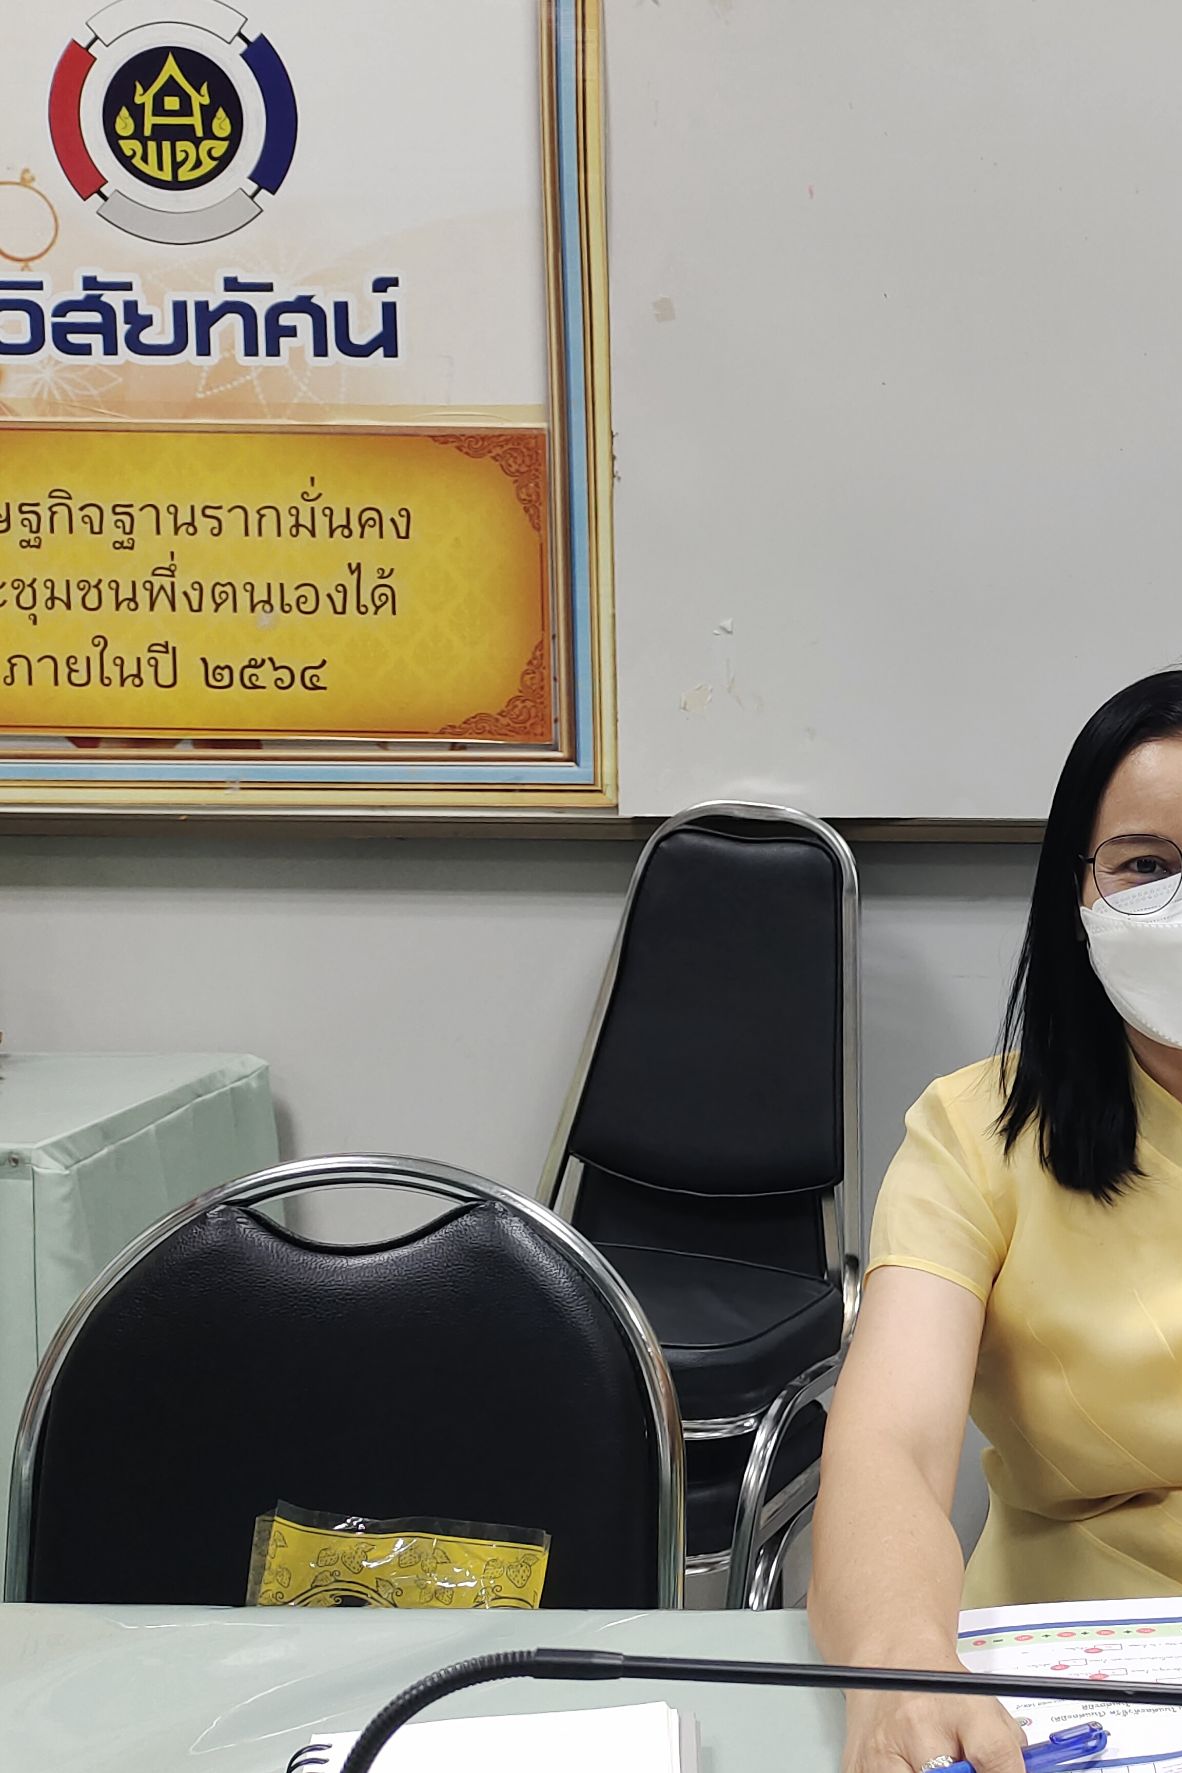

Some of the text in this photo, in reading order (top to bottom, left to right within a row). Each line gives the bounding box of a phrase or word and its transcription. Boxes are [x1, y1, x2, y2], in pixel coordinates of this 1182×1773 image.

[0, 275, 399, 359] วิสัยทัศน์
[3, 634, 328, 691] ภายในปี ๒๕๖๔
